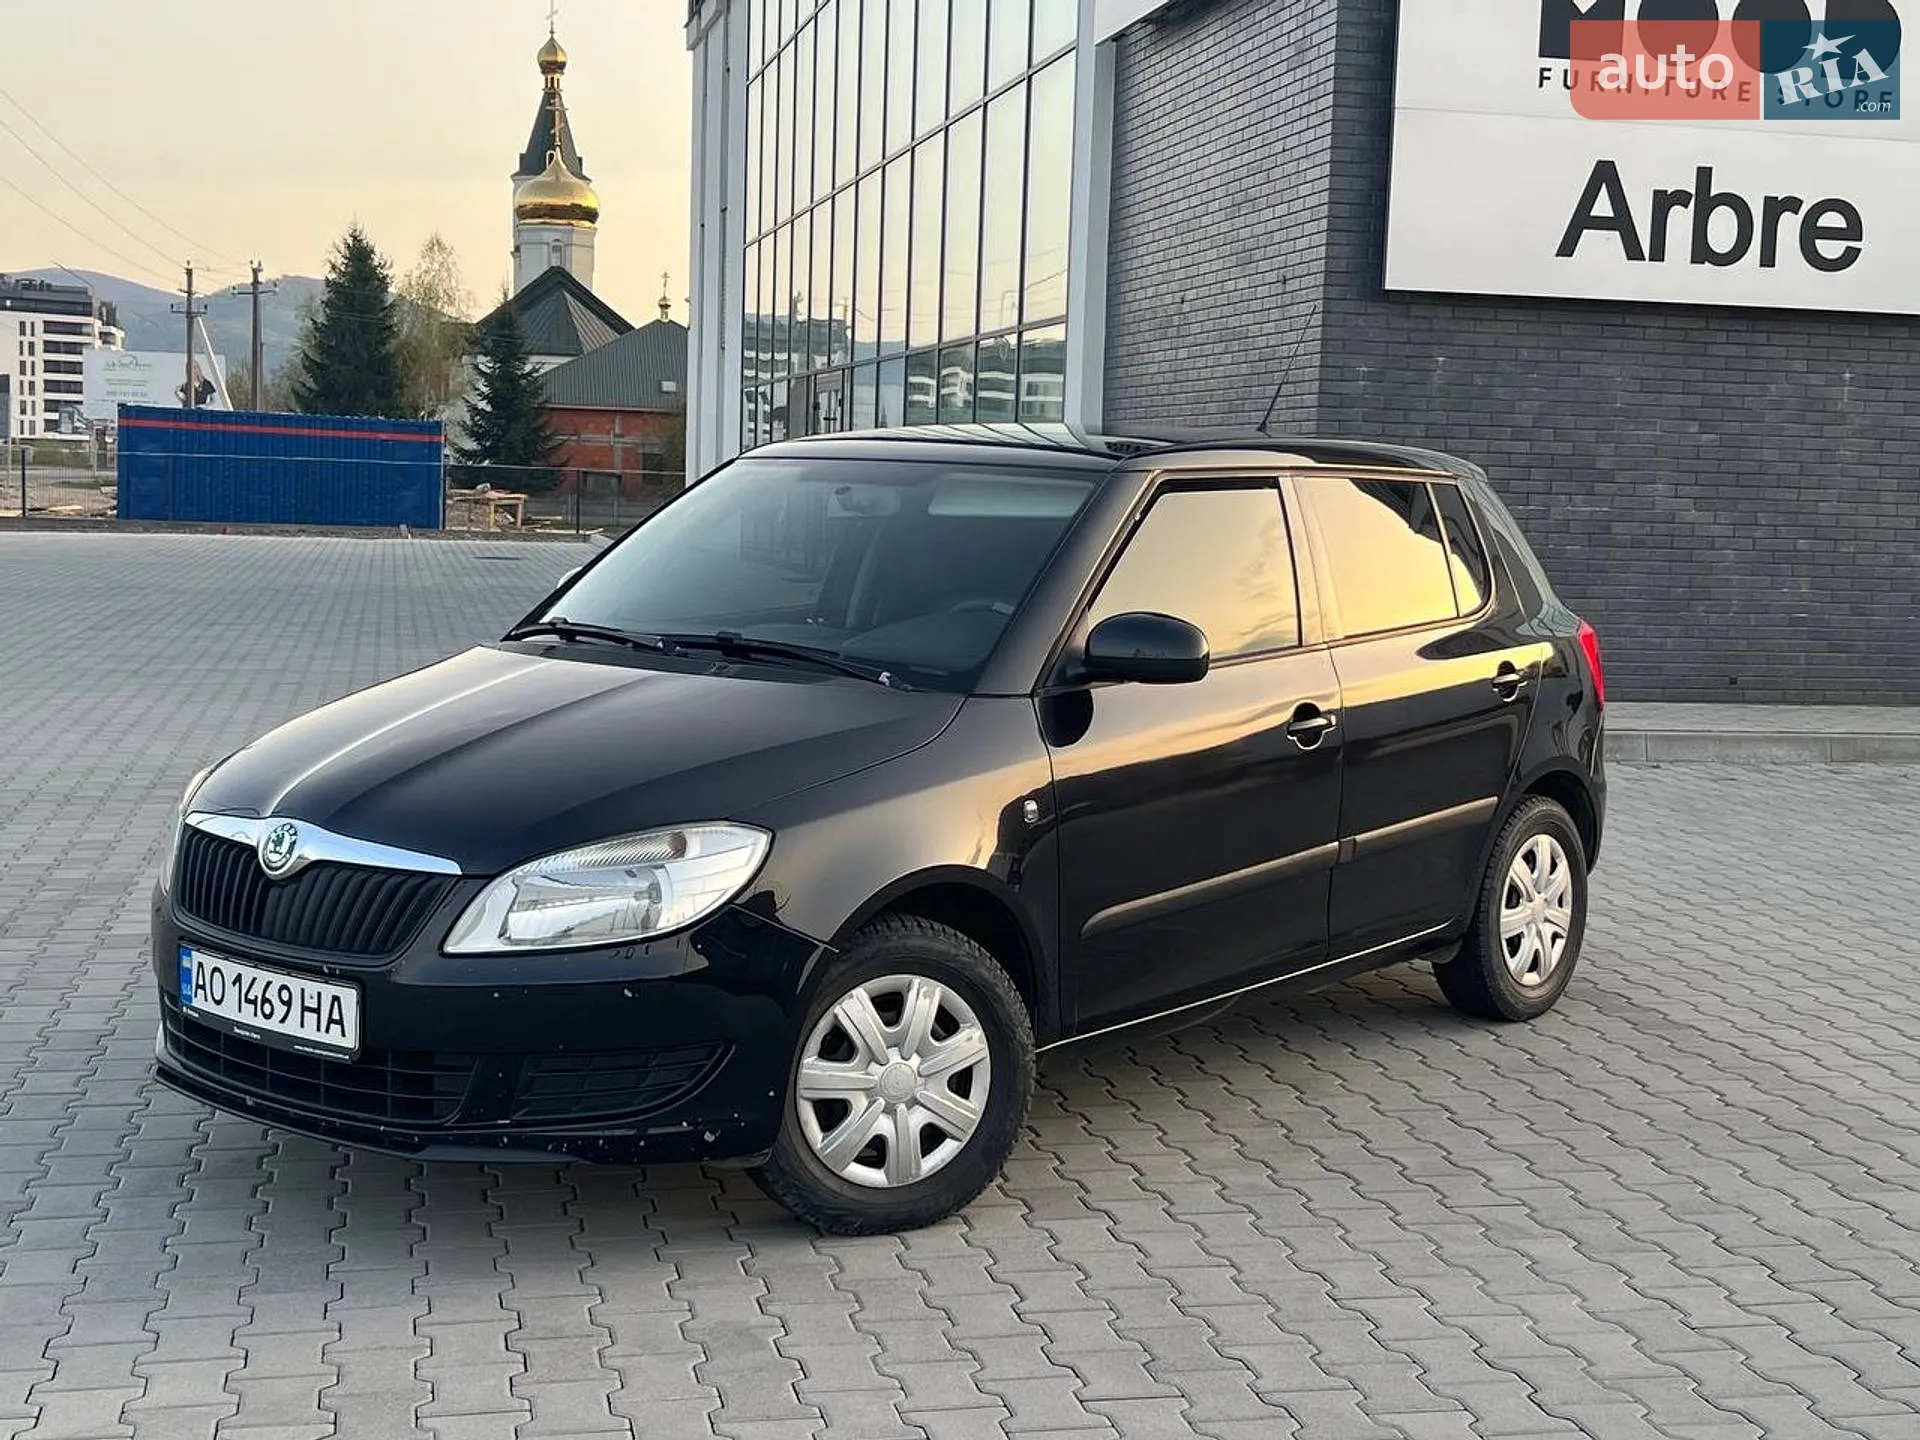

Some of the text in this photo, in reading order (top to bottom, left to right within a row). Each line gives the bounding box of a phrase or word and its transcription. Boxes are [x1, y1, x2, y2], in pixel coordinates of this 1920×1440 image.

[1538, 0, 1902, 80] MOOD
[1555, 159, 1863, 273] Arbre
[194, 961, 347, 1038] AO 1469 HA
